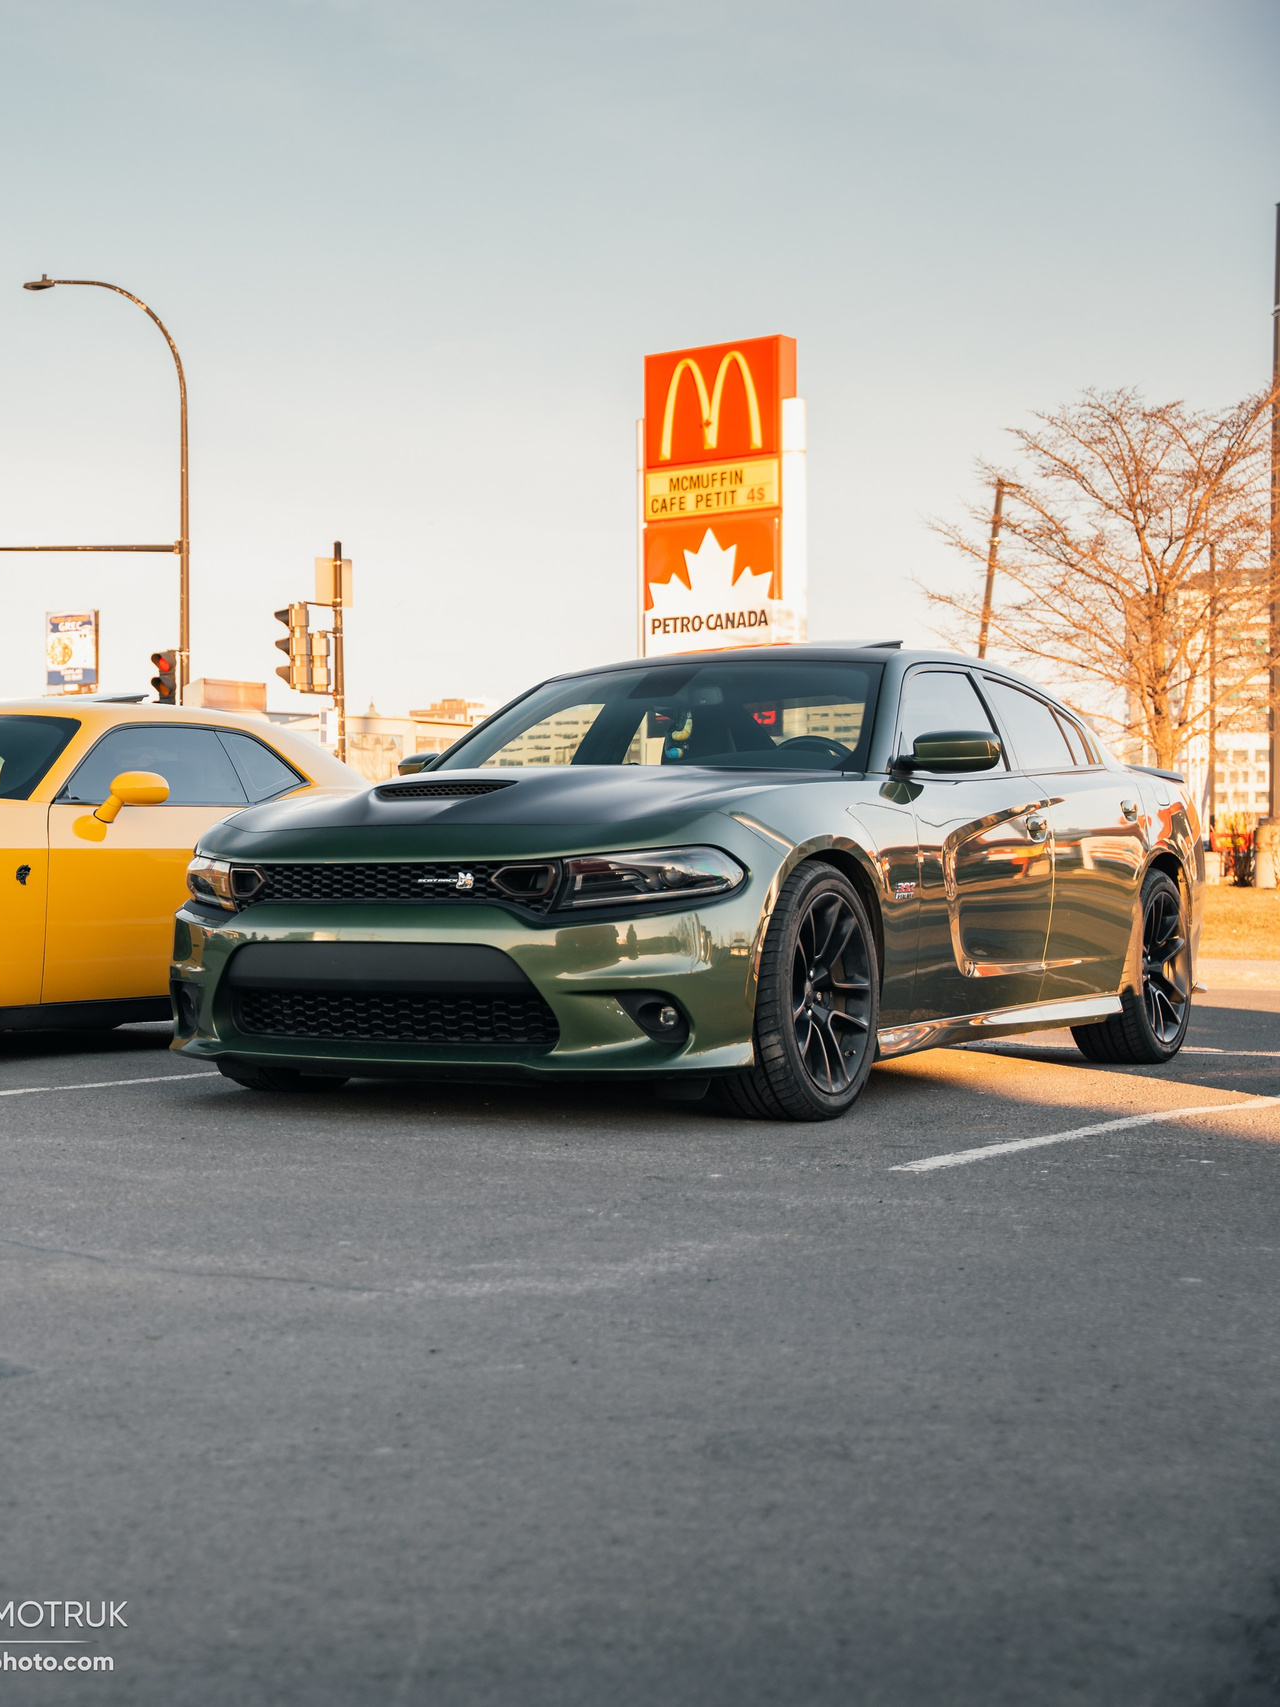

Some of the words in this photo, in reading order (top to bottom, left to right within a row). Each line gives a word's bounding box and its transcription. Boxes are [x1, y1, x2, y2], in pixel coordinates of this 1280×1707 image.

[669, 469, 743, 492] MCMUFFIN
[651, 496, 686, 513] CAFE
[695, 490, 737, 509] PETIT
[651, 609, 769, 635] PETRO-CANADA
[897, 882, 916, 892] 392
